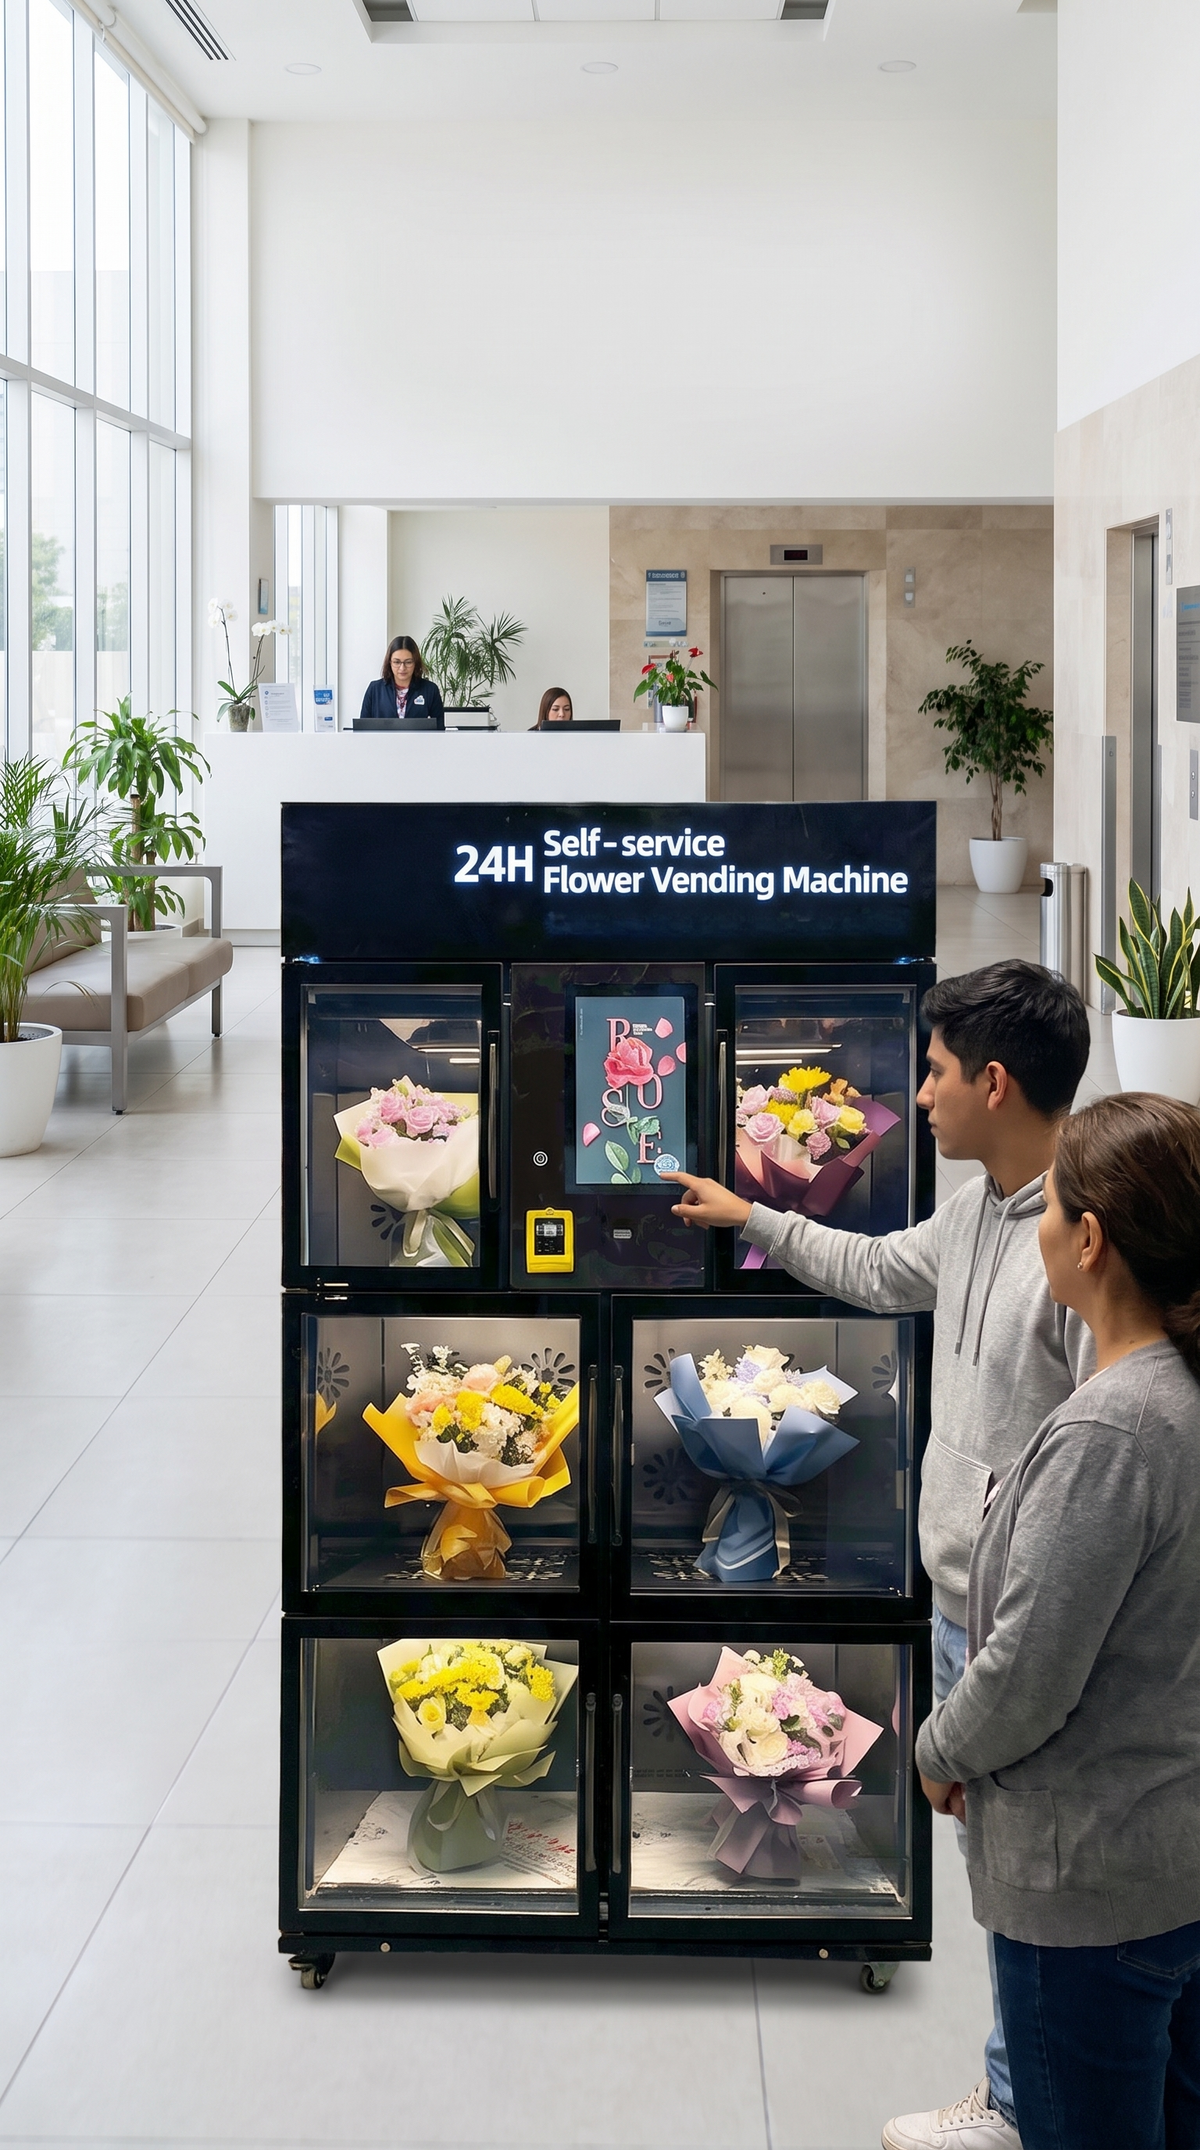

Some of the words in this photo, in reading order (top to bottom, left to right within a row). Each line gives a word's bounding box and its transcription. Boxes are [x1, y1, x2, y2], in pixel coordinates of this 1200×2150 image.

[454, 844, 534, 883] 24H
[543, 865, 645, 894] Flower
[651, 865, 775, 901] Vending
[783, 865, 909, 894] Machine
